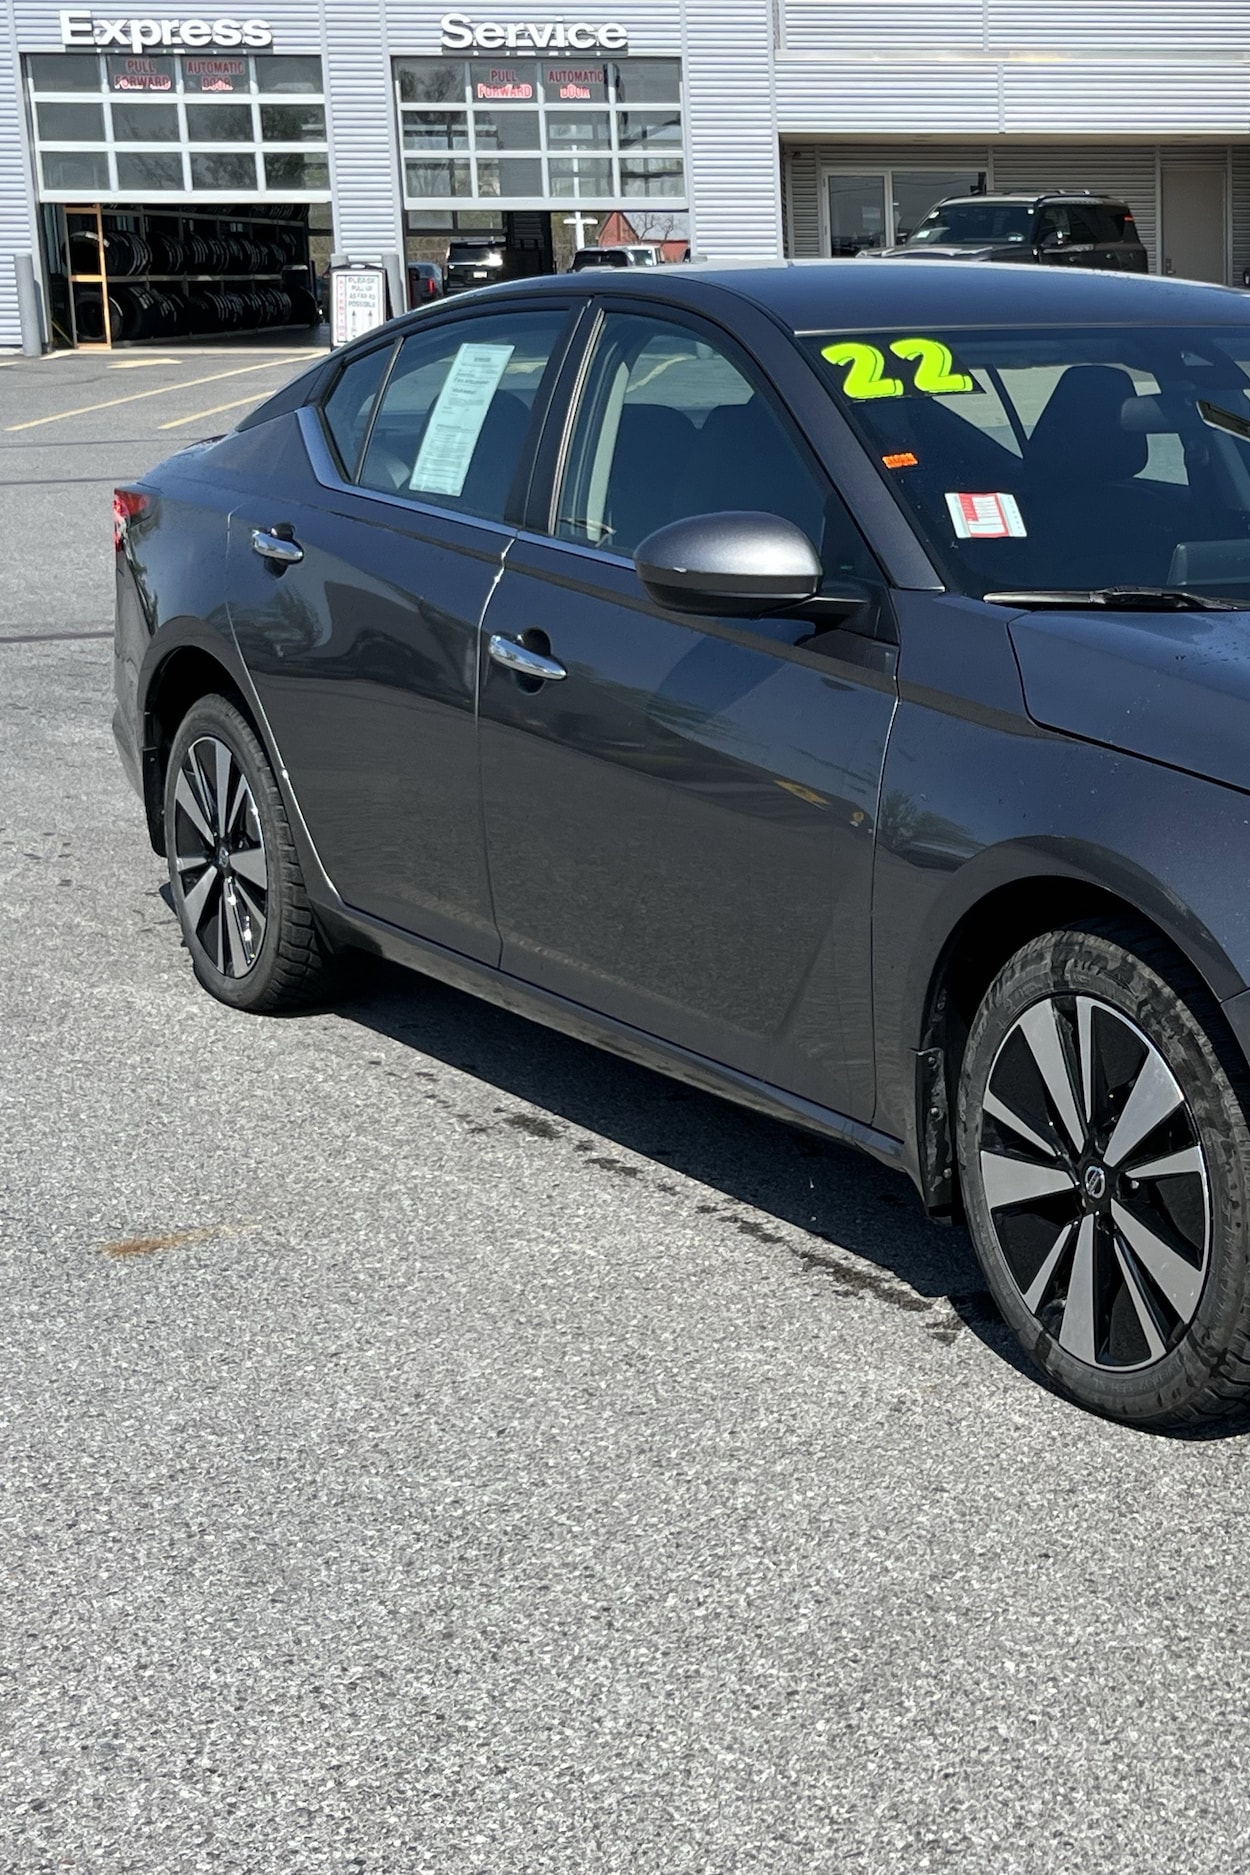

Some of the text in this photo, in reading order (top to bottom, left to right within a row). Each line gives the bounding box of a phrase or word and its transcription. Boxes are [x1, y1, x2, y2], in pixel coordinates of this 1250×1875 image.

[59, 10, 273, 54] Express
[440, 13, 629, 49] Service
[127, 59, 156, 74] PULL
[186, 60, 245, 75] AUTOMATIC
[114, 75, 172, 90] FORWARD
[490, 68, 518, 83] PULL
[549, 68, 604, 83] AUTOMATIC
[201, 76, 234, 91] DOOR
[477, 83, 532, 99] FORWARD
[560, 83, 590, 99] DOOR
[821, 338, 974, 400] 22
